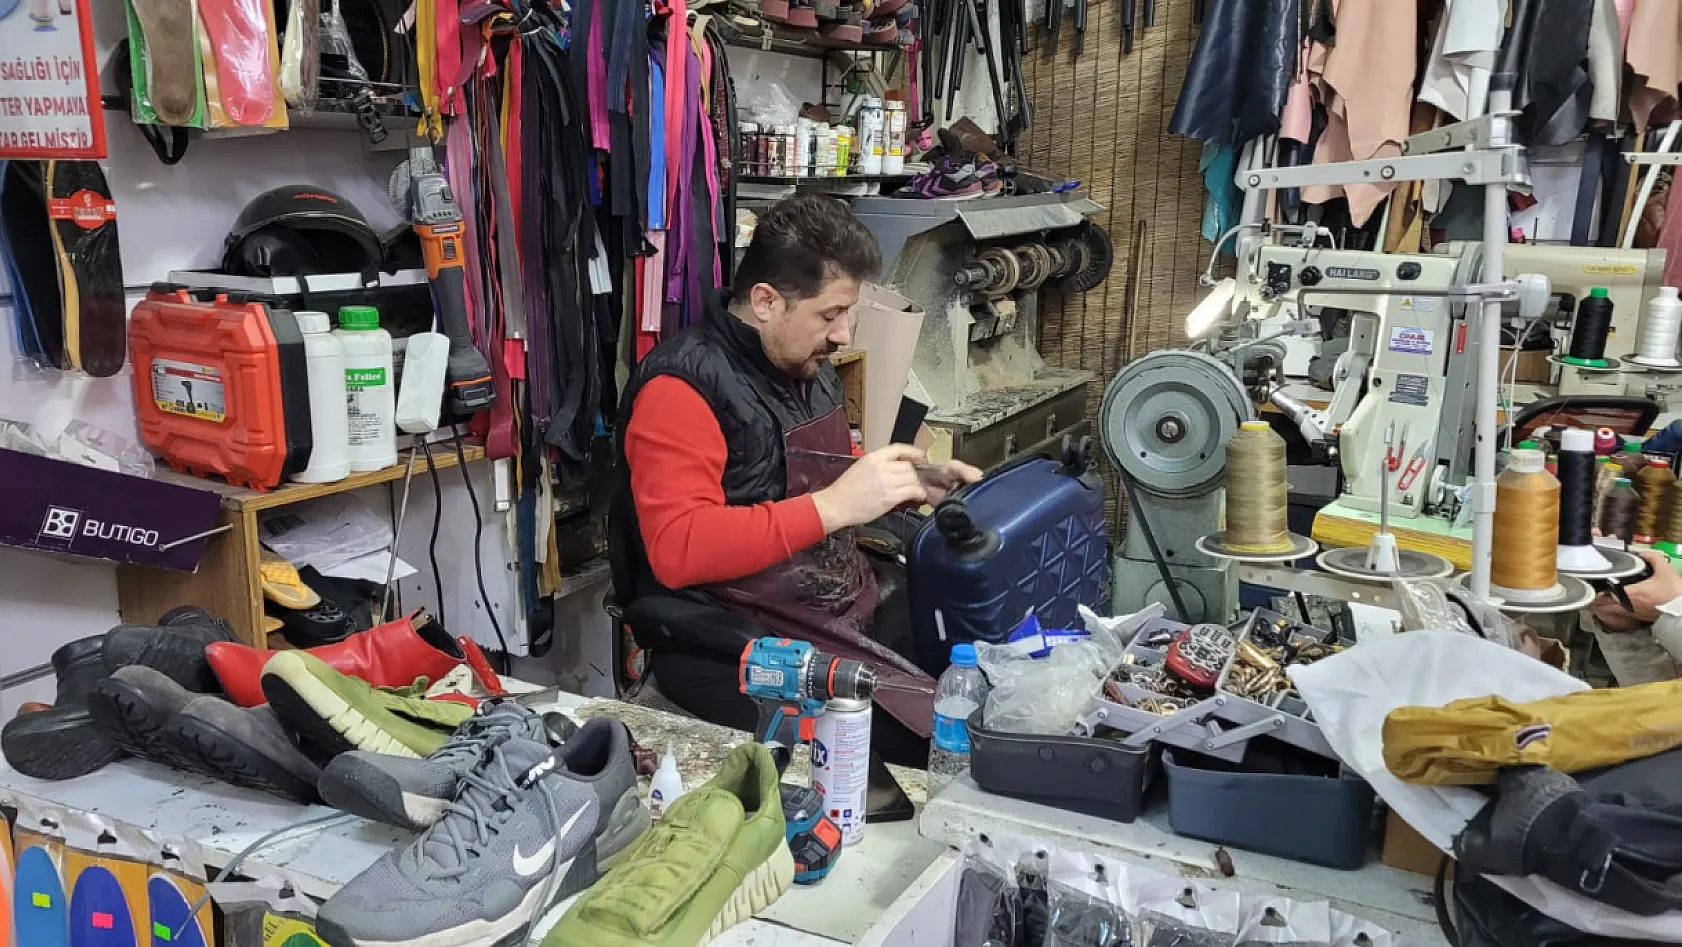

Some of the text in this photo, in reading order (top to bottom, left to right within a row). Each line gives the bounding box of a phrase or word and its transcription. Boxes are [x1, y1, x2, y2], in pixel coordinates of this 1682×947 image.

[0, 55, 81, 85] SAĞLIĞI İÇİN
[0, 97, 23, 117] TER
[1329, 268, 1346, 277] HAI
[83, 519, 159, 546] BUTIGO
